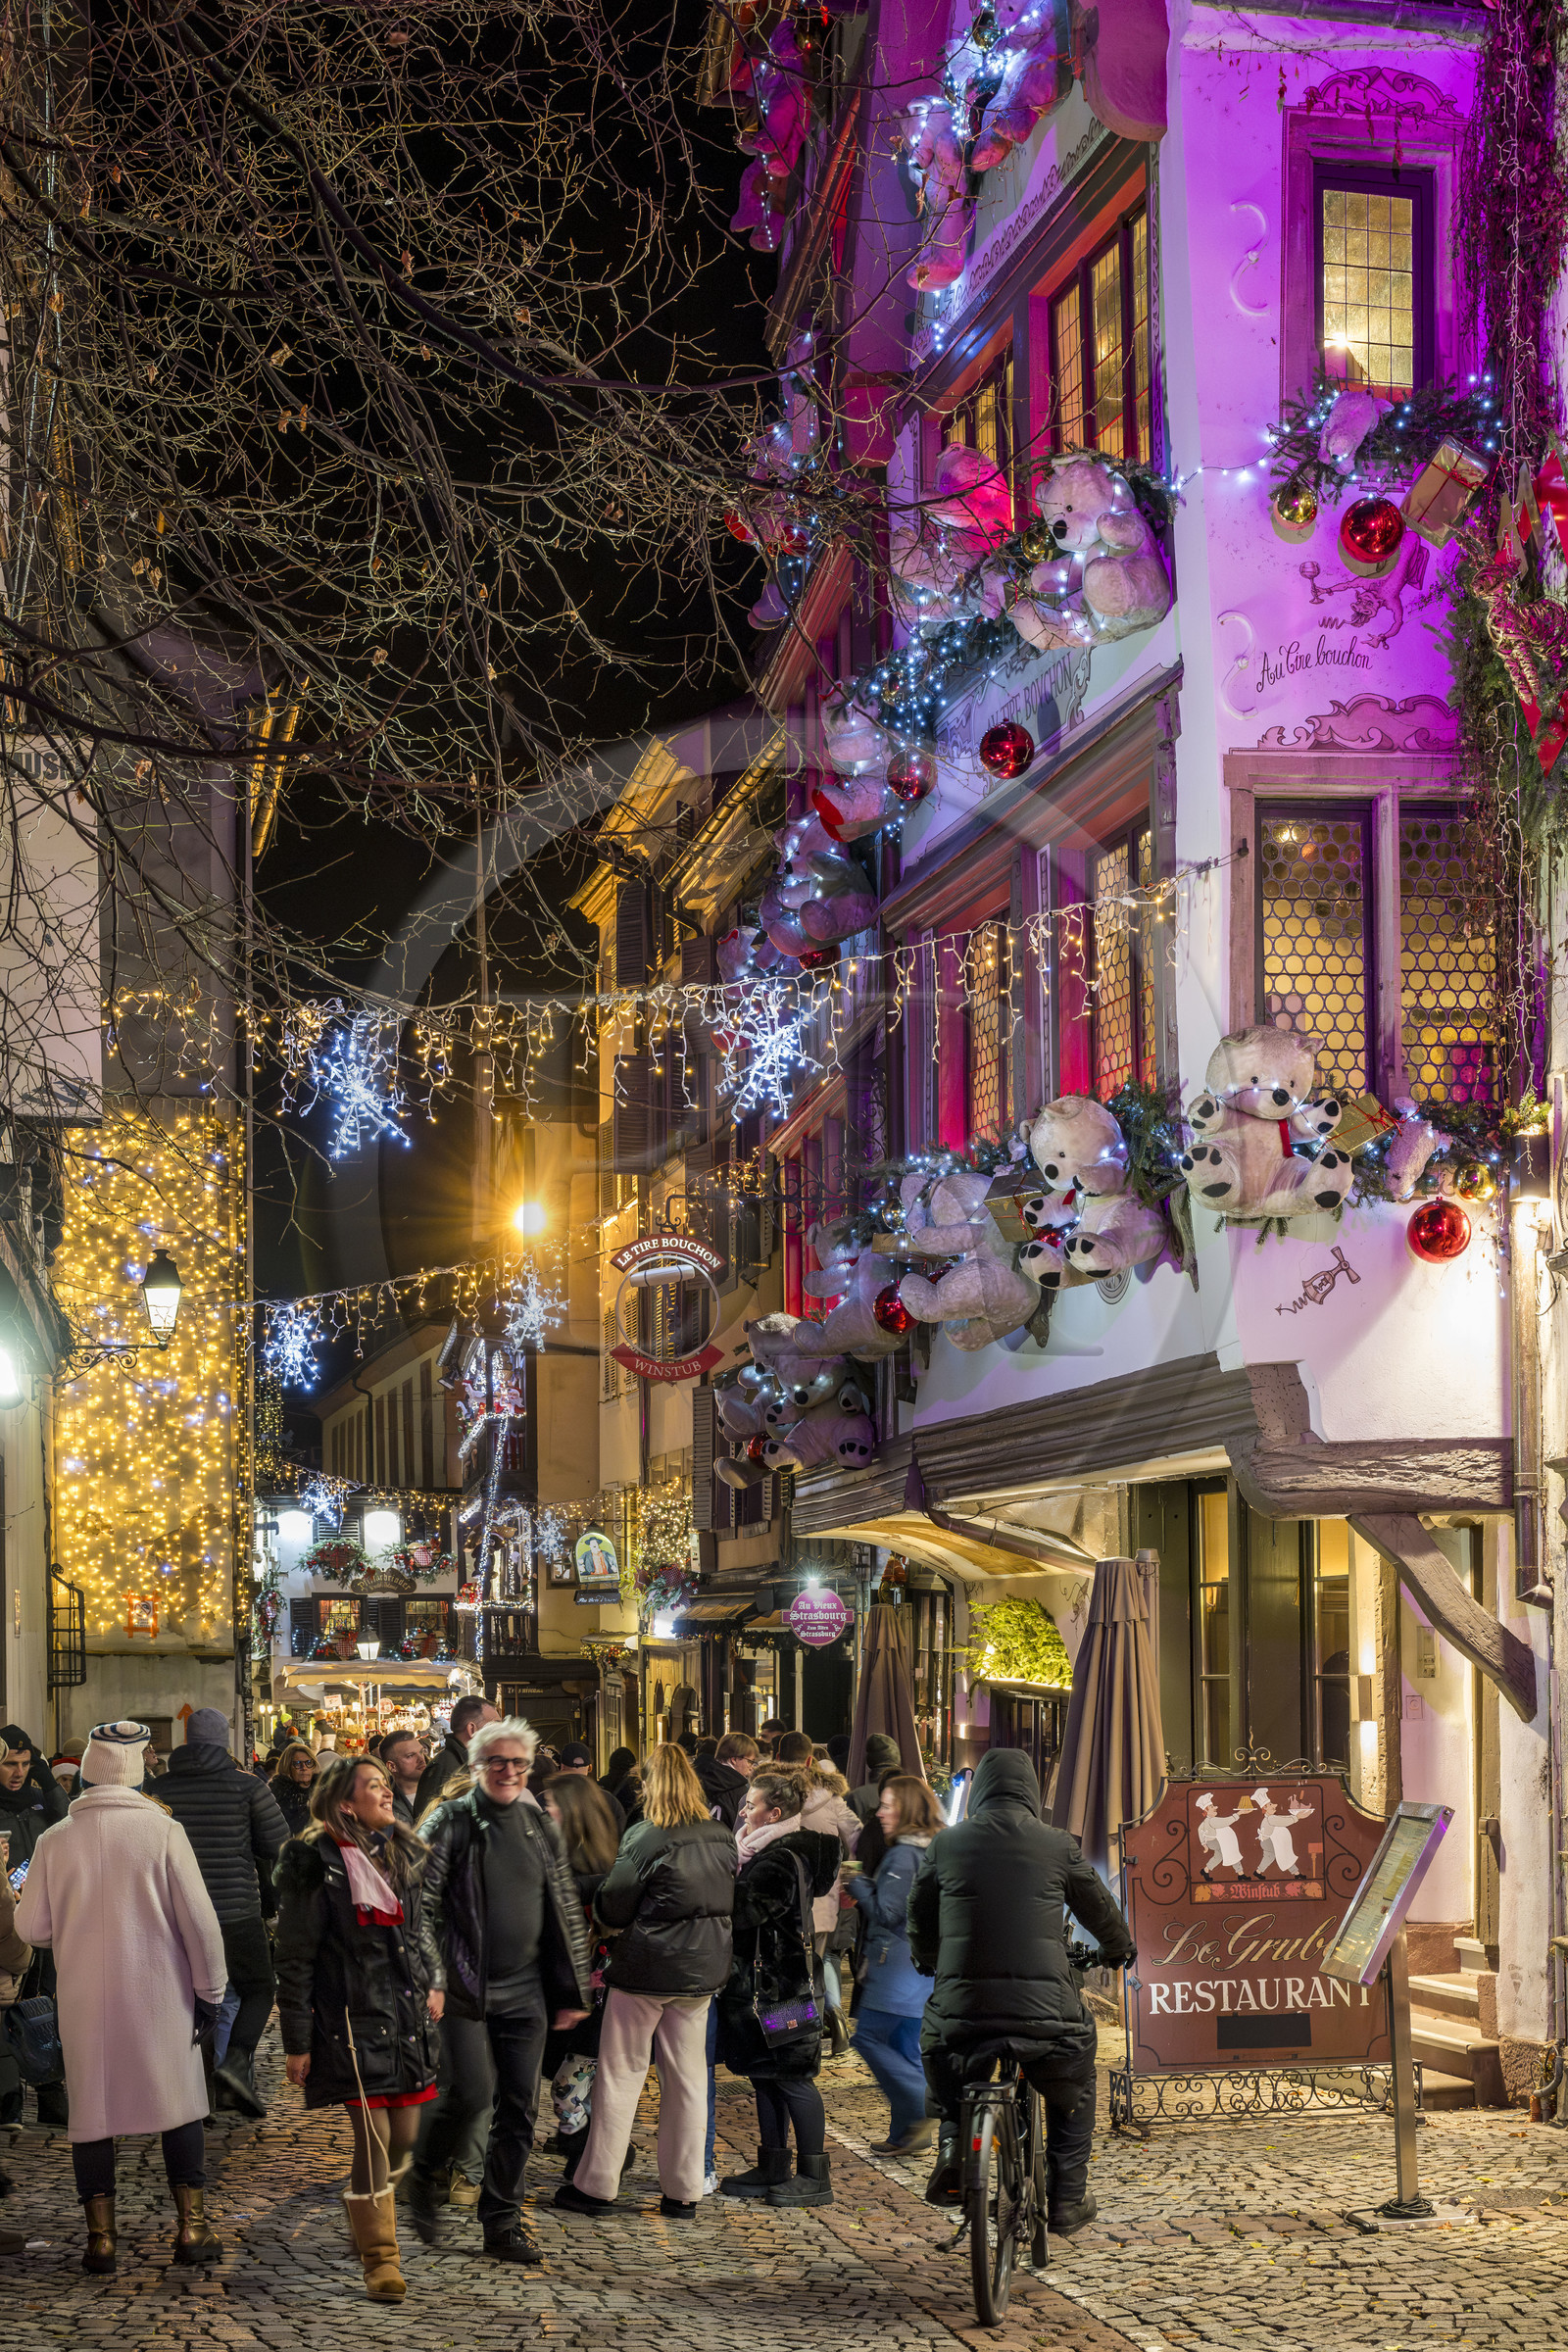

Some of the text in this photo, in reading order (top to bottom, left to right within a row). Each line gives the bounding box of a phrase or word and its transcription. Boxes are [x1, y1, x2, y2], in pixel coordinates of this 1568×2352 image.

[1255, 651, 1285, 693] Au
[1314, 634, 1372, 669] bouchon
[616, 1237, 721, 1269] LE TIRE BOUCHON
[634, 1358, 703, 1378] WINSTUB
[789, 1610, 848, 1622] Strasbourg
[798, 1600, 811, 1610] Au
[1151, 1919, 1221, 1967] Le
[1148, 1975, 1370, 2015] RESTAURANT
